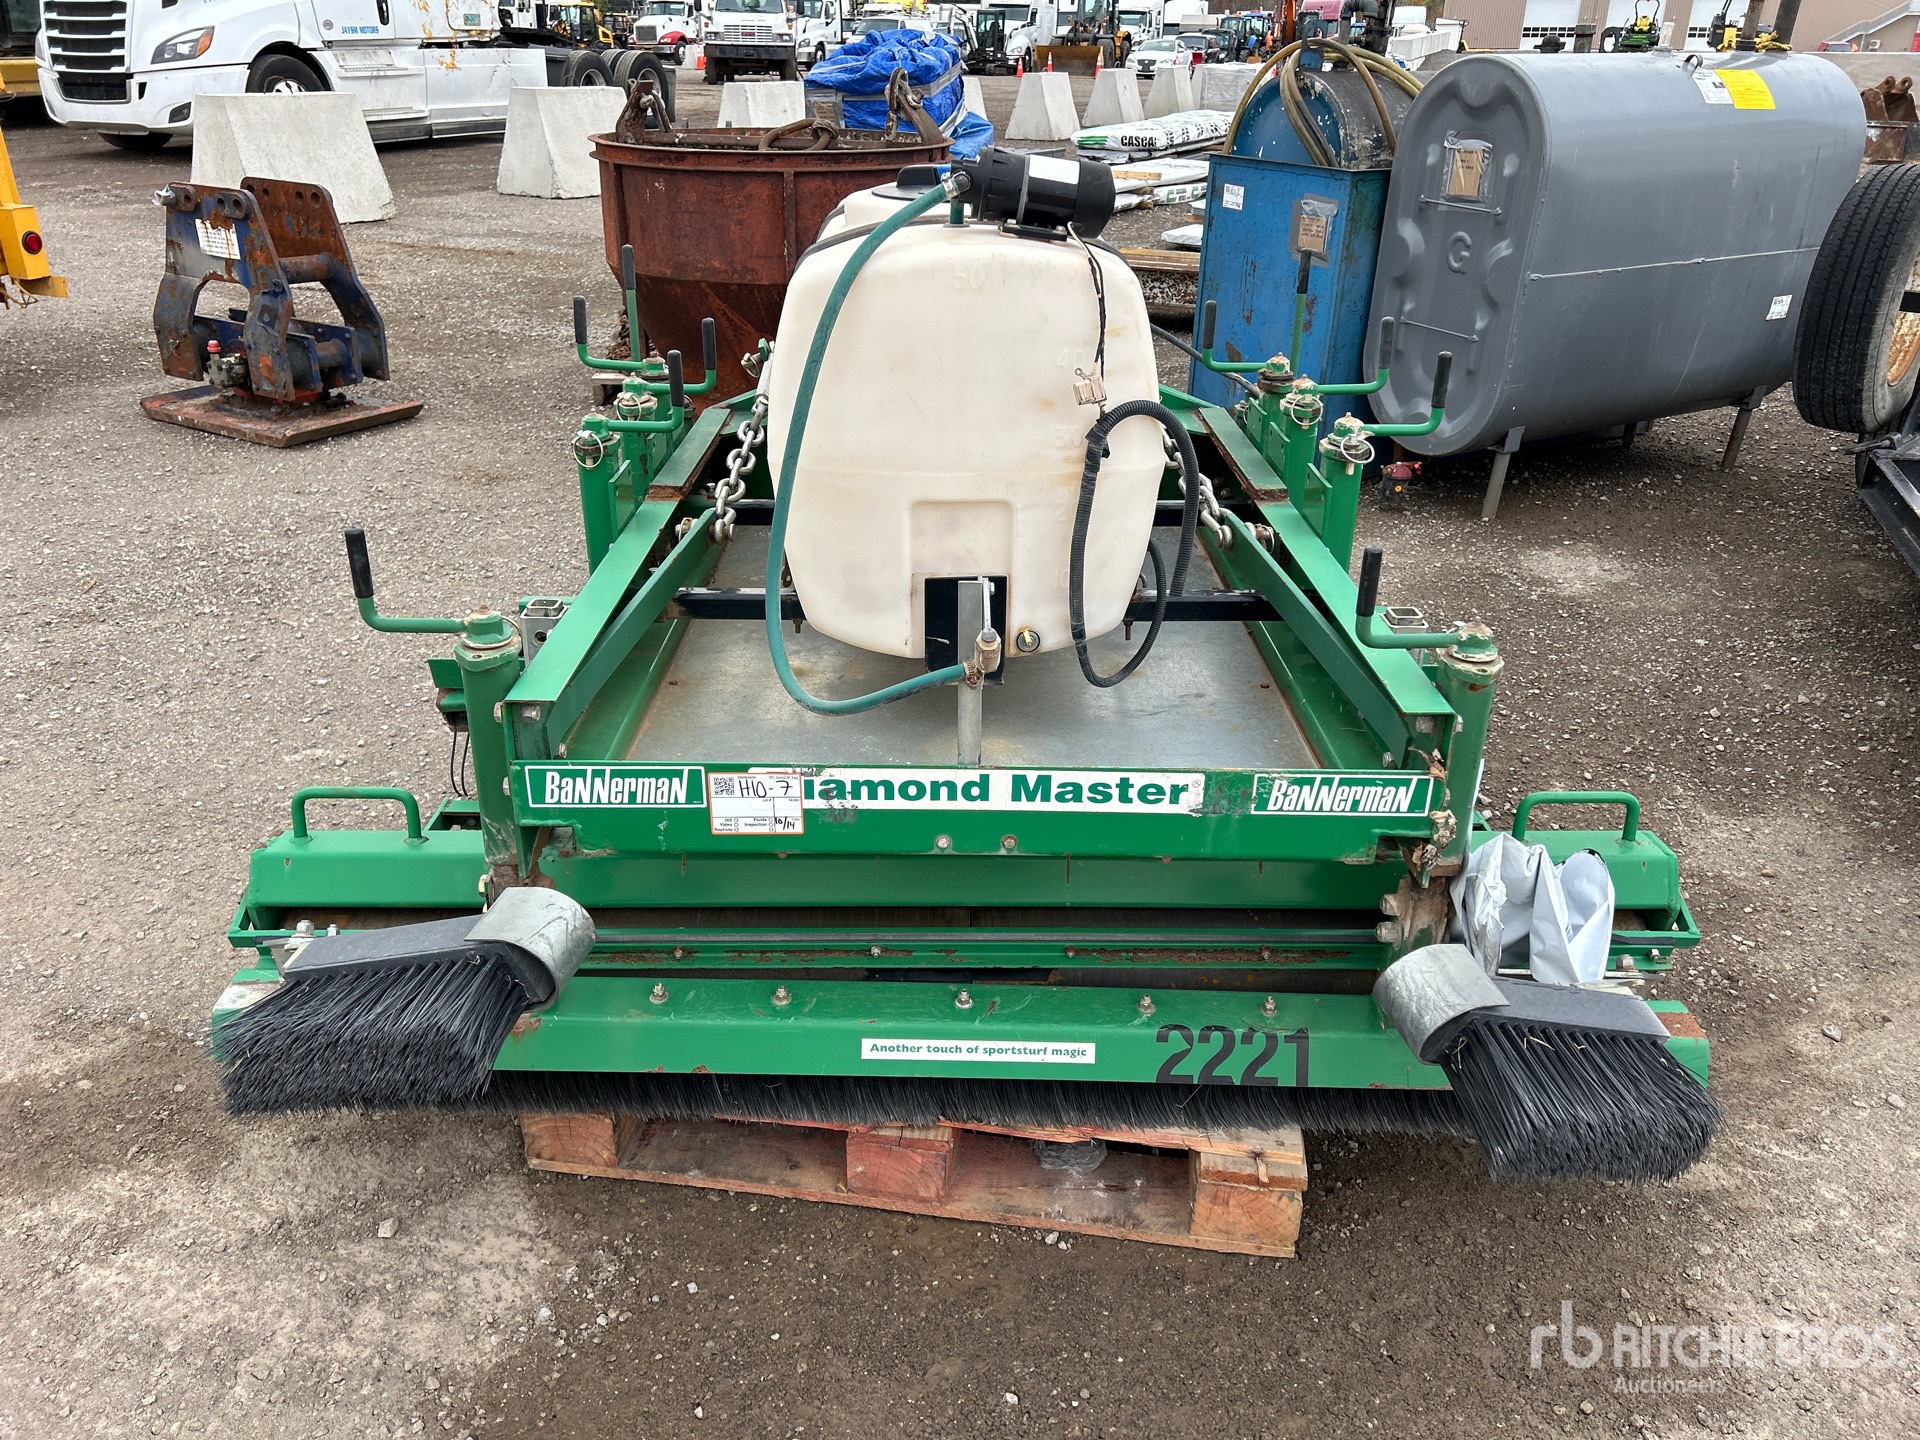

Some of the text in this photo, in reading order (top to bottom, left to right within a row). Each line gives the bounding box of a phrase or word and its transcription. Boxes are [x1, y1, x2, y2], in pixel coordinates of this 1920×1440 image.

[804, 773, 990, 803] iamond
[869, 1043, 1088, 1058] Another touch of sportsturf magic
[1155, 1024, 1310, 1087] 2221
